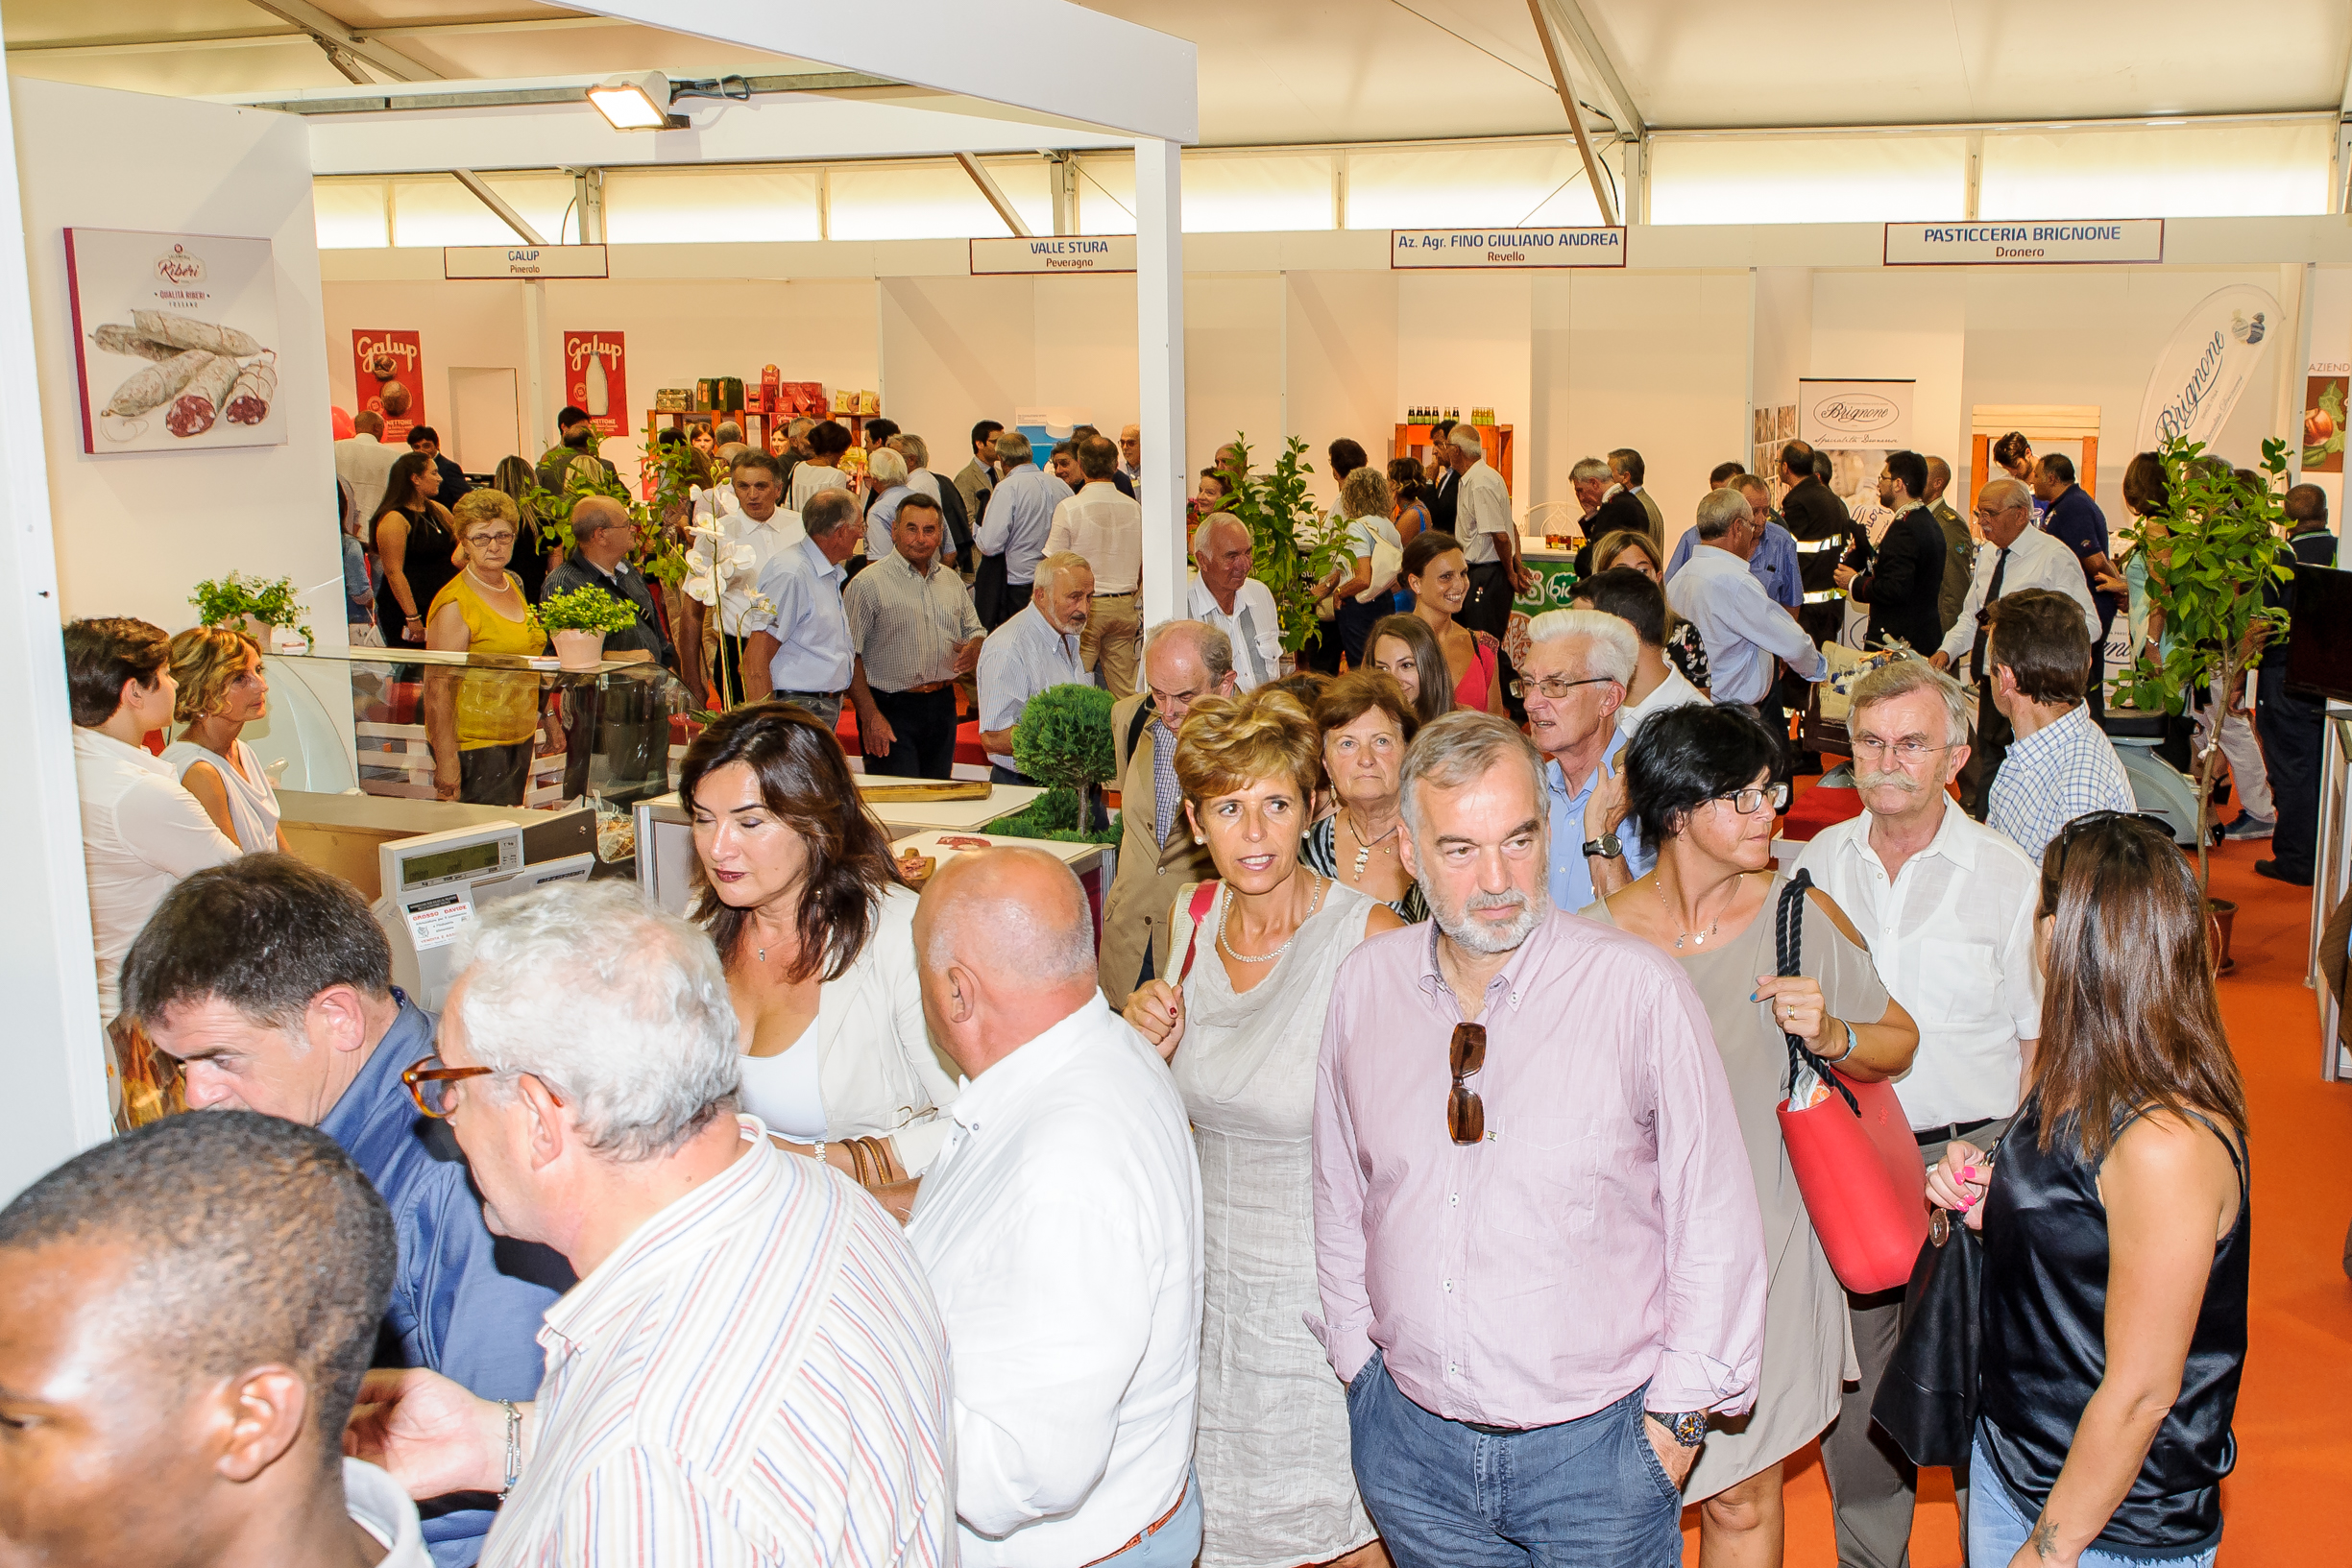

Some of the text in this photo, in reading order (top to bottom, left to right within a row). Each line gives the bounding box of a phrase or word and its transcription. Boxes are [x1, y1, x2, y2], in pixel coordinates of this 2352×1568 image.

[1924, 226, 2122, 242] PASTICCERIA BRIGNONE
[1031, 241, 1108, 254] VALLE STURA
[1397, 232, 1619, 251] Az. Agr. FINO GIULIANO ANDREA
[508, 251, 540, 261] GALUP
[1488, 251, 1525, 261] Revello
[1996, 246, 2045, 257] Dronero
[510, 264, 541, 274] Pinerolo
[1046, 258, 1094, 269] Peveragno
[158, 258, 200, 284] Riberi
[356, 333, 418, 374] Galup
[568, 334, 622, 372] Galup
[2155, 331, 2225, 452] Brignone
[1820, 401, 1889, 423] Brignone
[412, 911, 440, 922] GROSSO
